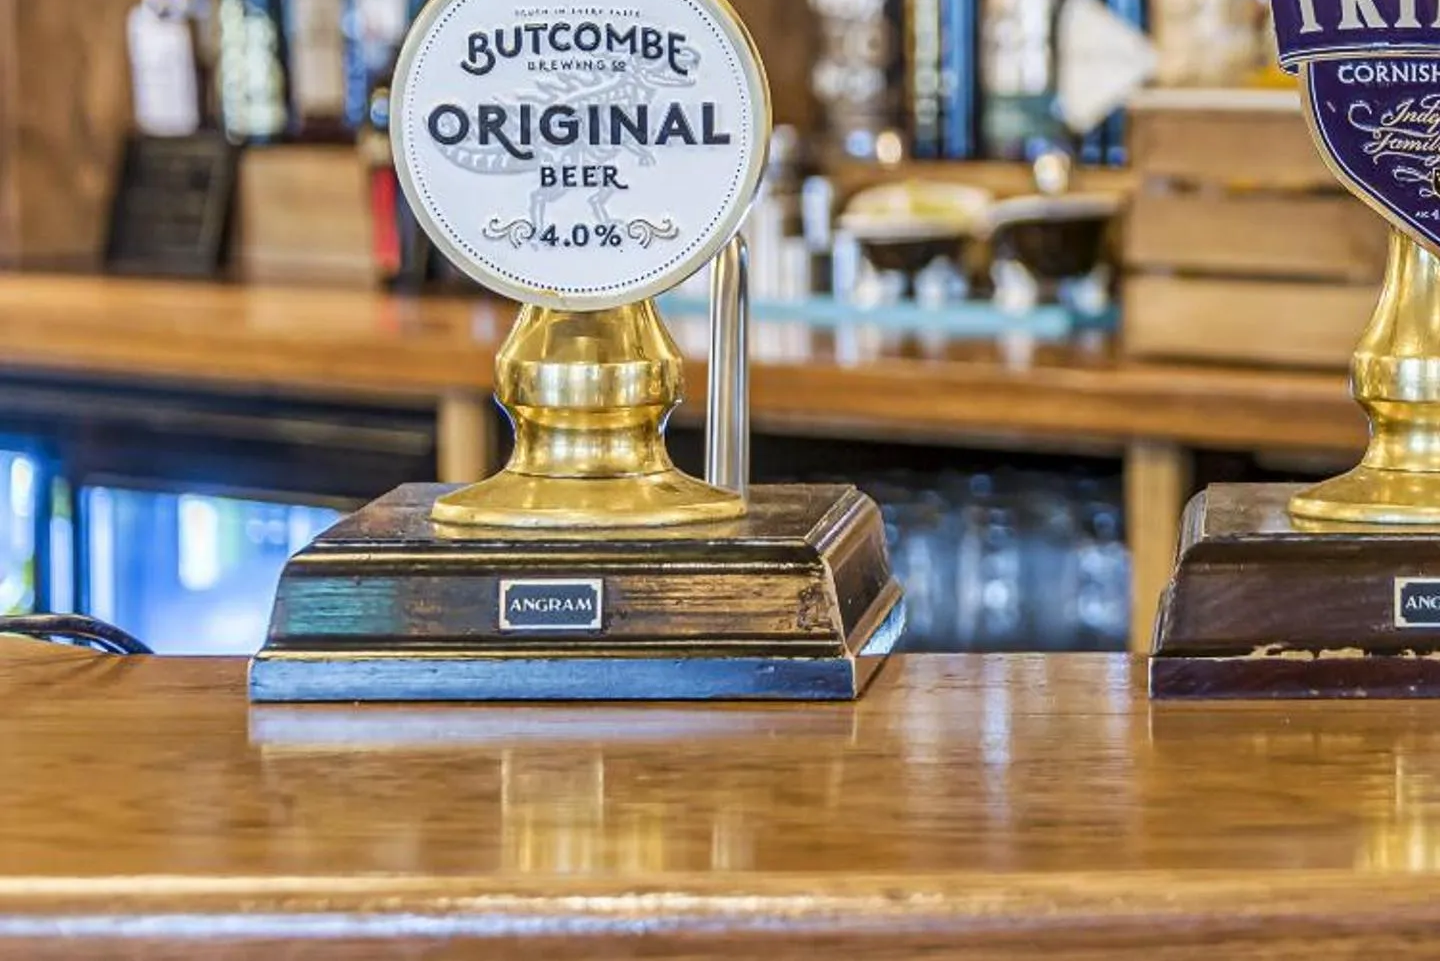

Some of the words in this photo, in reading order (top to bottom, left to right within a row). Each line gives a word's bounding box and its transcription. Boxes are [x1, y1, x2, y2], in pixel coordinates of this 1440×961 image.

[461, 21, 689, 76] BUTCOMBE
[527, 59, 606, 72] BREWING
[427, 101, 731, 160] ORIGINAL
[540, 165, 629, 190] BEER
[539, 224, 623, 247] 4.0%
[509, 597, 593, 612] ANGRAM
